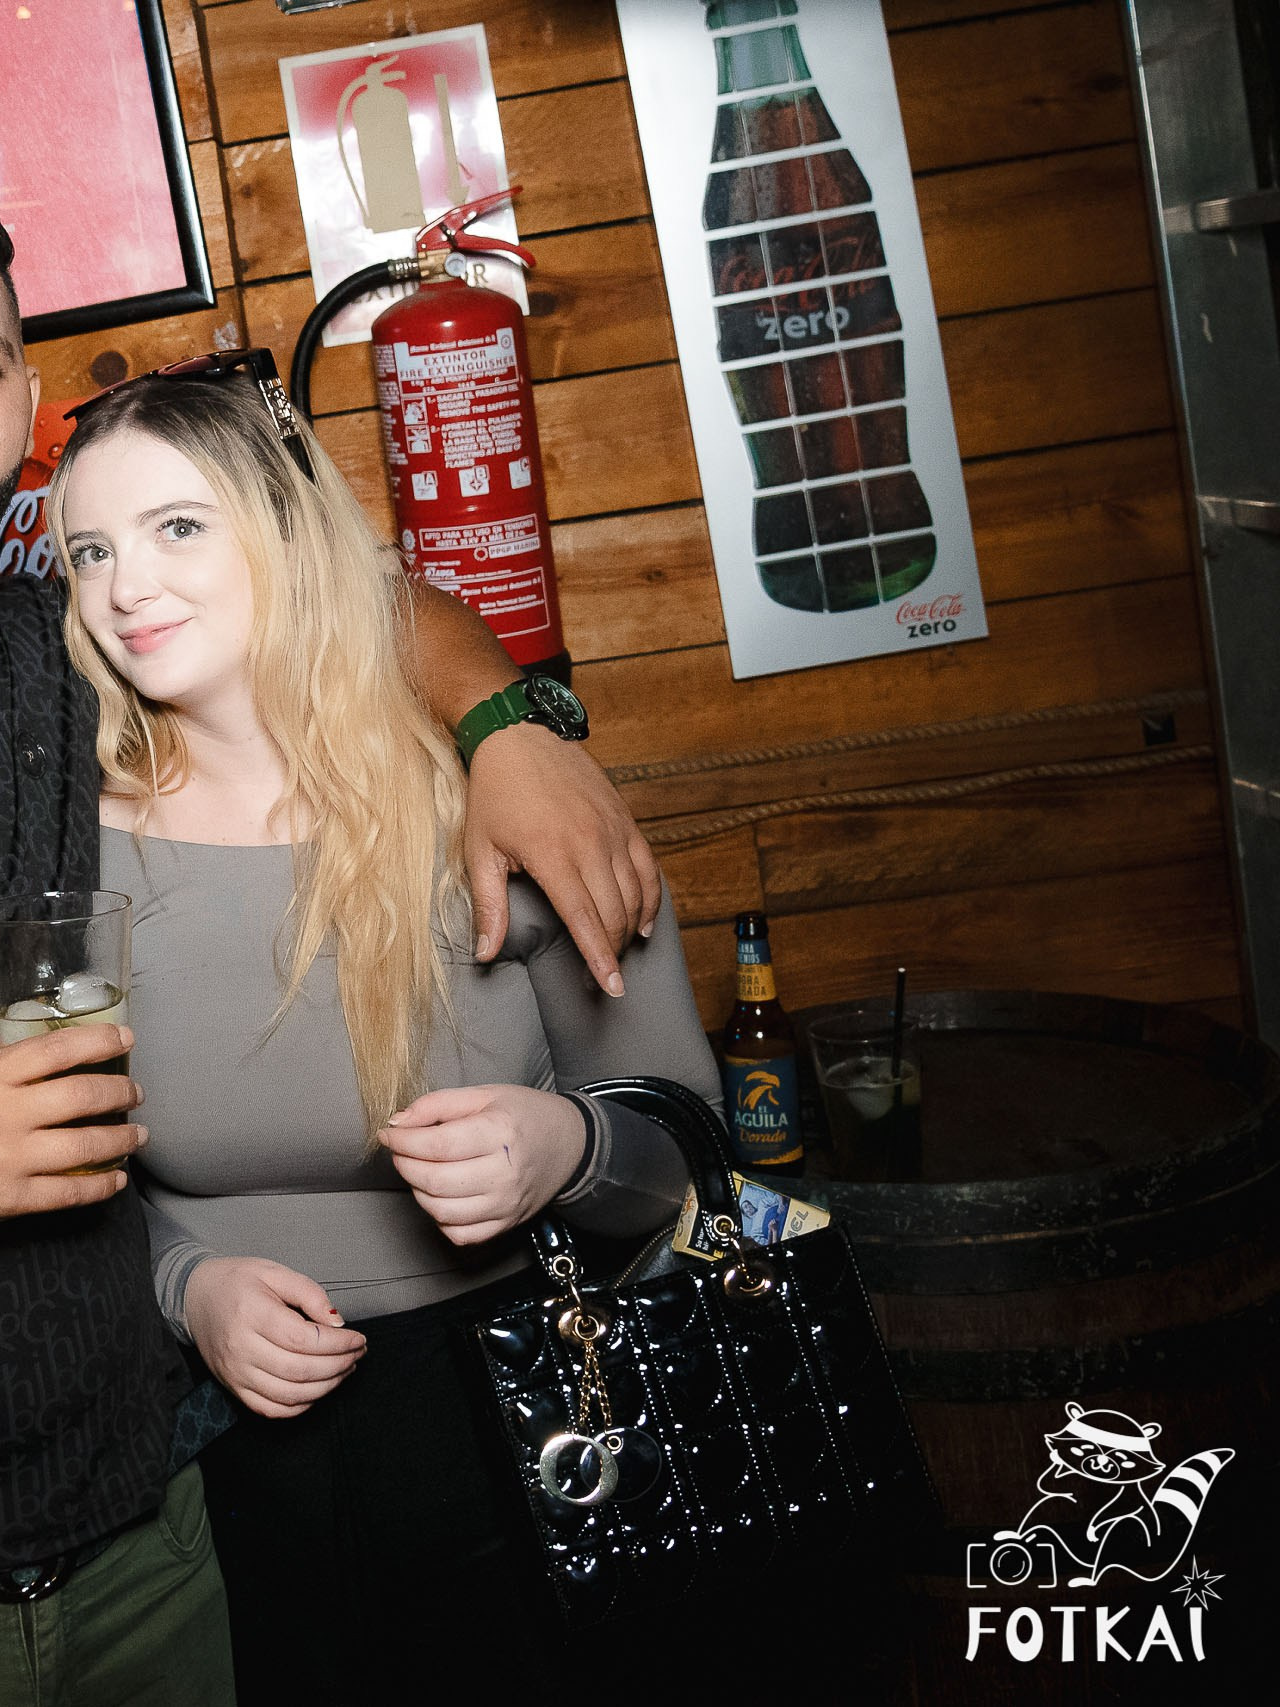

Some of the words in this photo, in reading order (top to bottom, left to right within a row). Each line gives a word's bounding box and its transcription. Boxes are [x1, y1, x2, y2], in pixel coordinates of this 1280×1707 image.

[756, 306, 850, 340] zero
[423, 349, 487, 366] EXTINTOR
[400, 369, 424, 379] FIRE
[908, 619, 956, 638] zero
